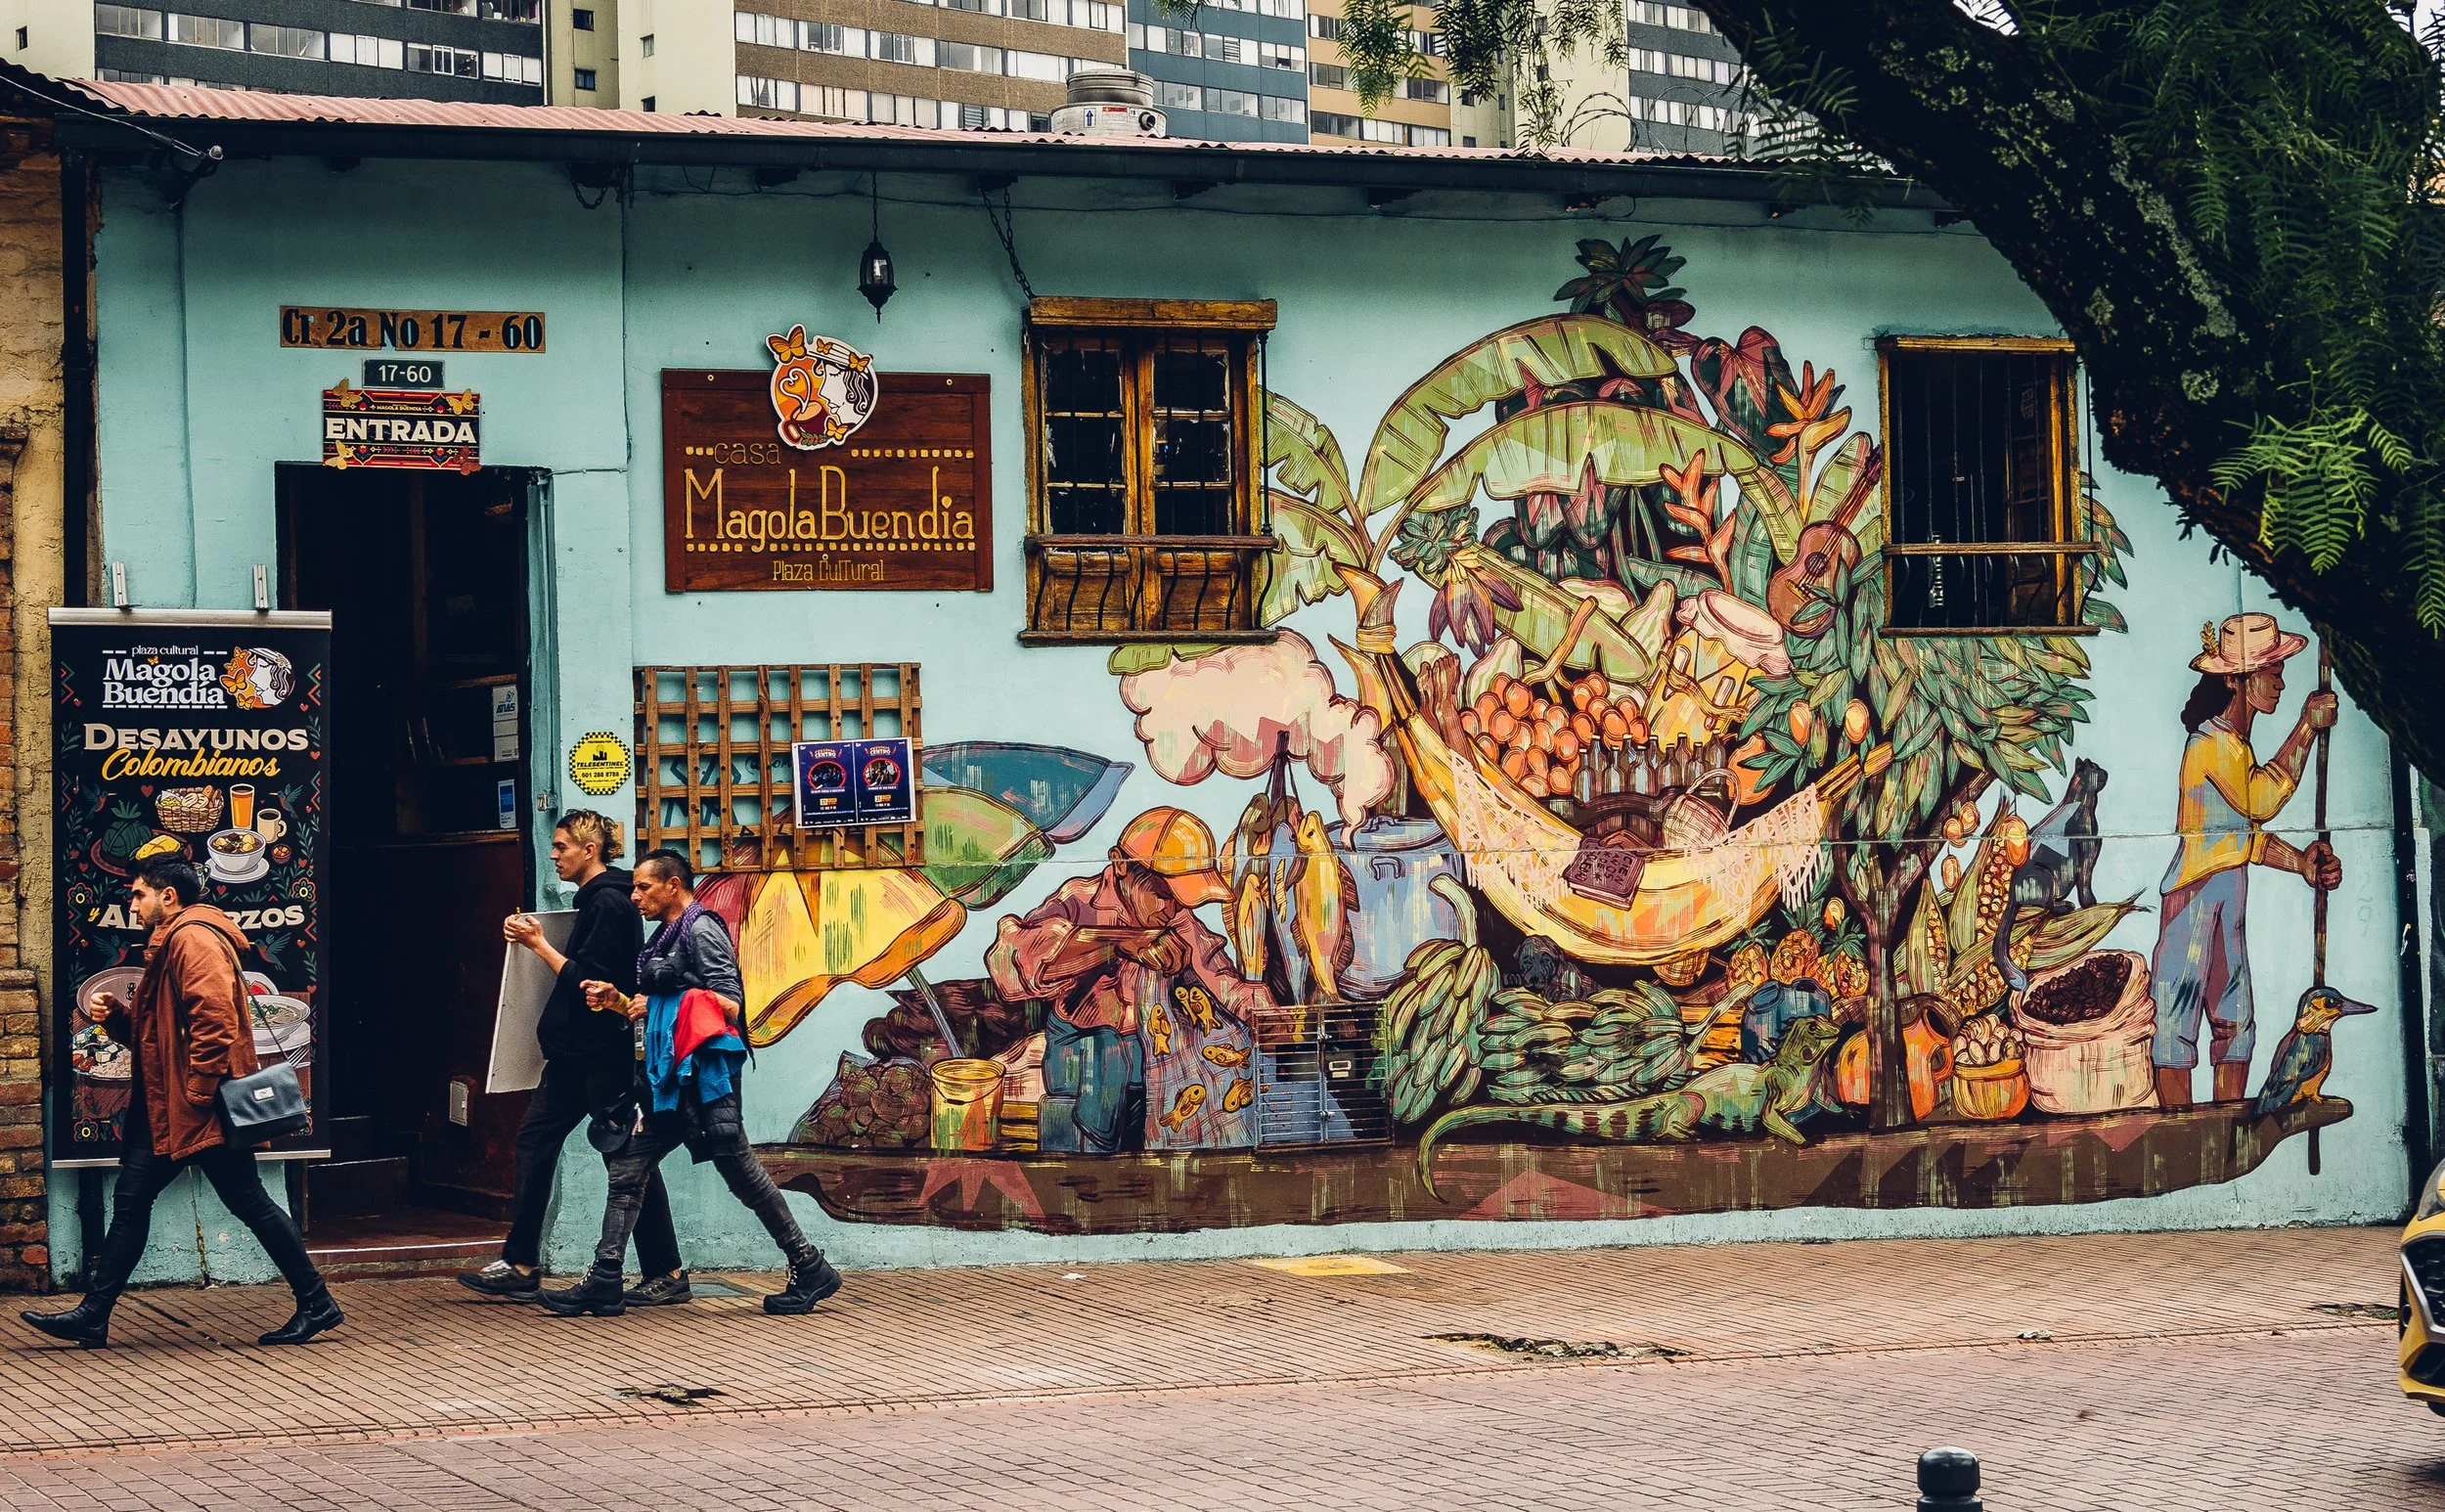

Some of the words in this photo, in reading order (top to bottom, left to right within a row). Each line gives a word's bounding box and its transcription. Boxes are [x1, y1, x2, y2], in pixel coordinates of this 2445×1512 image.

[327, 311, 367, 346] 2a
[379, 313, 420, 348] No
[431, 314, 467, 348] 17
[502, 315, 544, 349] 60
[378, 365, 431, 383] 17-60
[325, 418, 477, 444] ENTRADA
[714, 441, 780, 465] casa
[773, 559, 814, 582] Plaza
[132, 645, 157, 657] plaza
[159, 645, 199, 655] cultural
[103, 657, 217, 688] Magola
[103, 681, 225, 704] Buendía
[83, 724, 309, 751] DESAYUNOS
[102, 747, 282, 781] Colombianos
[1597, 858, 1608, 869] DE
[1614, 856, 1633, 886] CIEN
